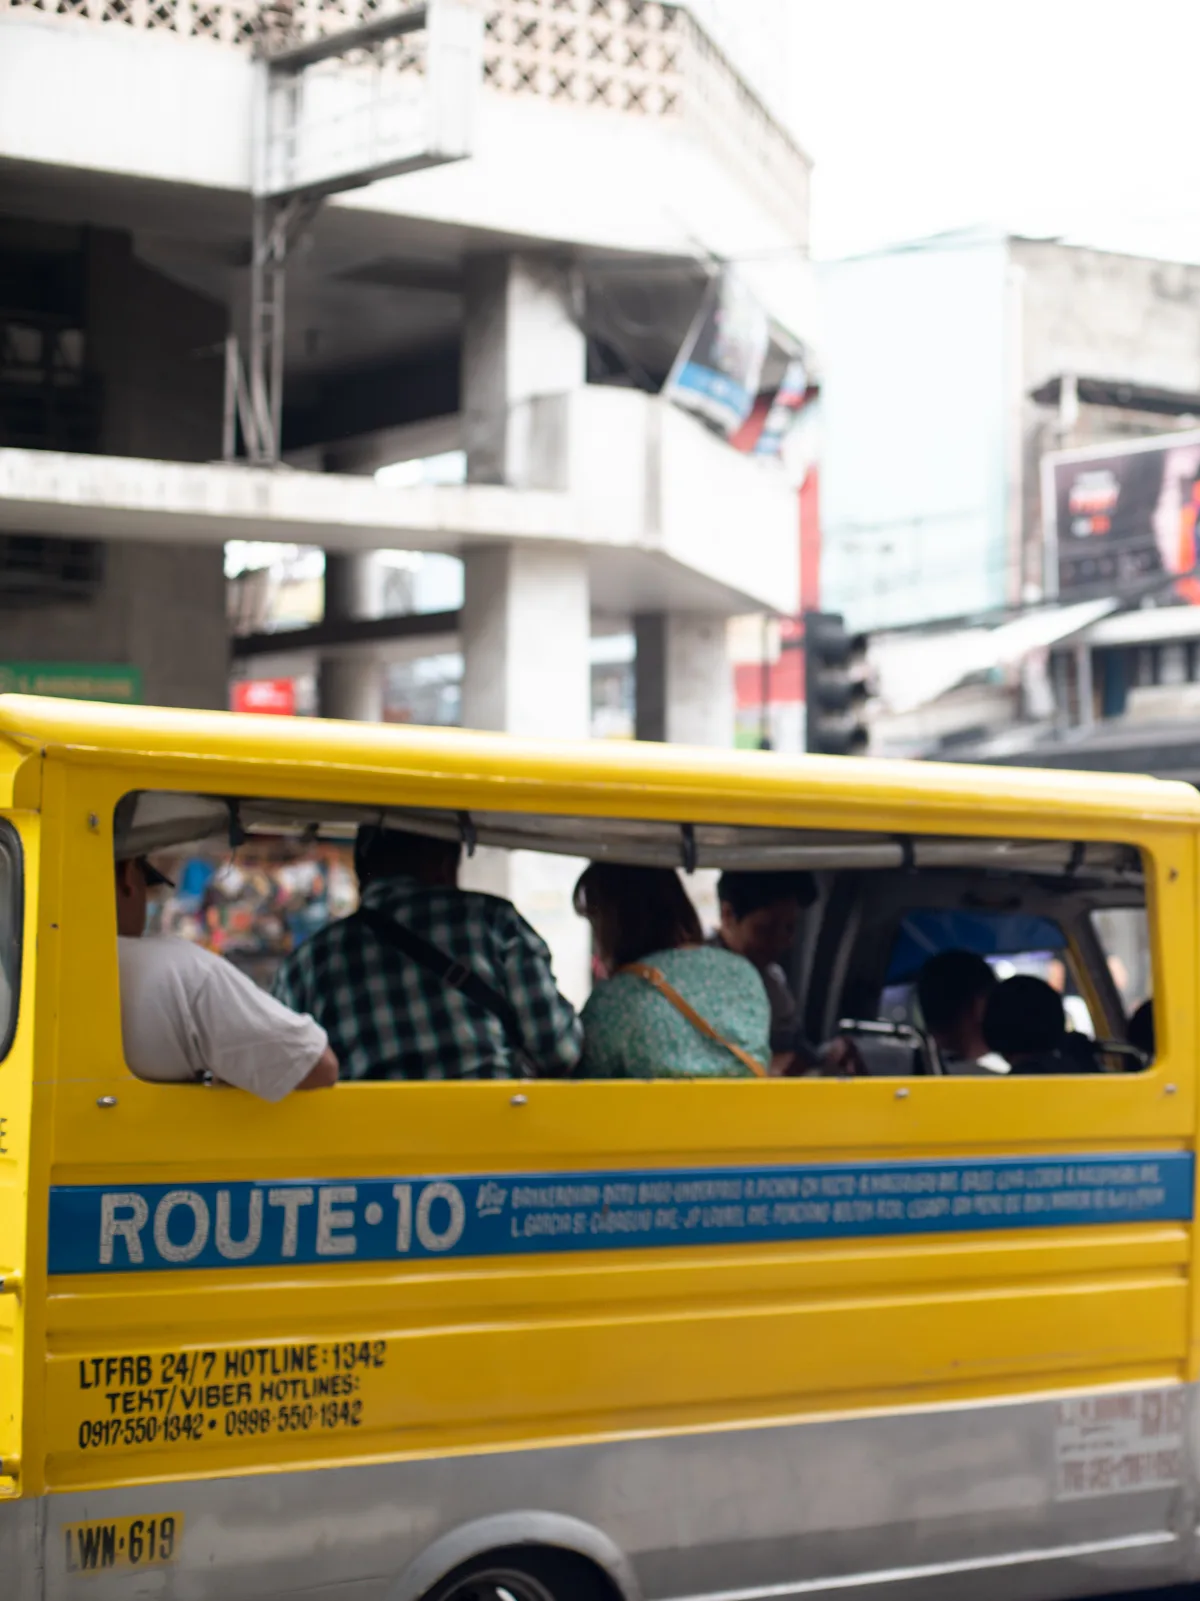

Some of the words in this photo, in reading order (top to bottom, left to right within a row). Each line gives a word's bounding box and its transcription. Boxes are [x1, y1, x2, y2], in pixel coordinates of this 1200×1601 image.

[79, 1354, 153, 1390] LTFRB
[160, 1350, 217, 1386] 24/7
[259, 1375, 361, 1404] HOTLINES:
